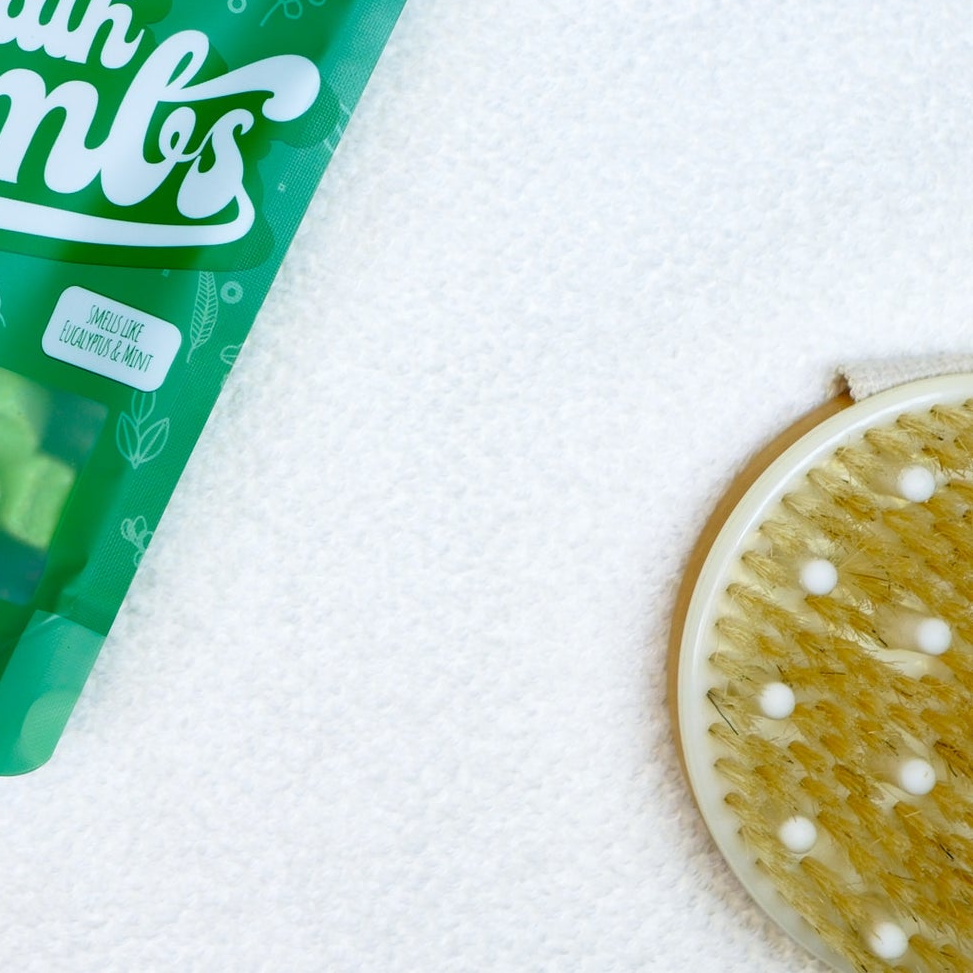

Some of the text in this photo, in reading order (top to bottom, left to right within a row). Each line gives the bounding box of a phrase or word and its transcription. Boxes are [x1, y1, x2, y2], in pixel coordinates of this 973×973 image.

[59, 319, 113, 357] EUCALYPTUS
[110, 340, 122, 362] &
[86, 304, 145, 343] SMELLS LIKE
